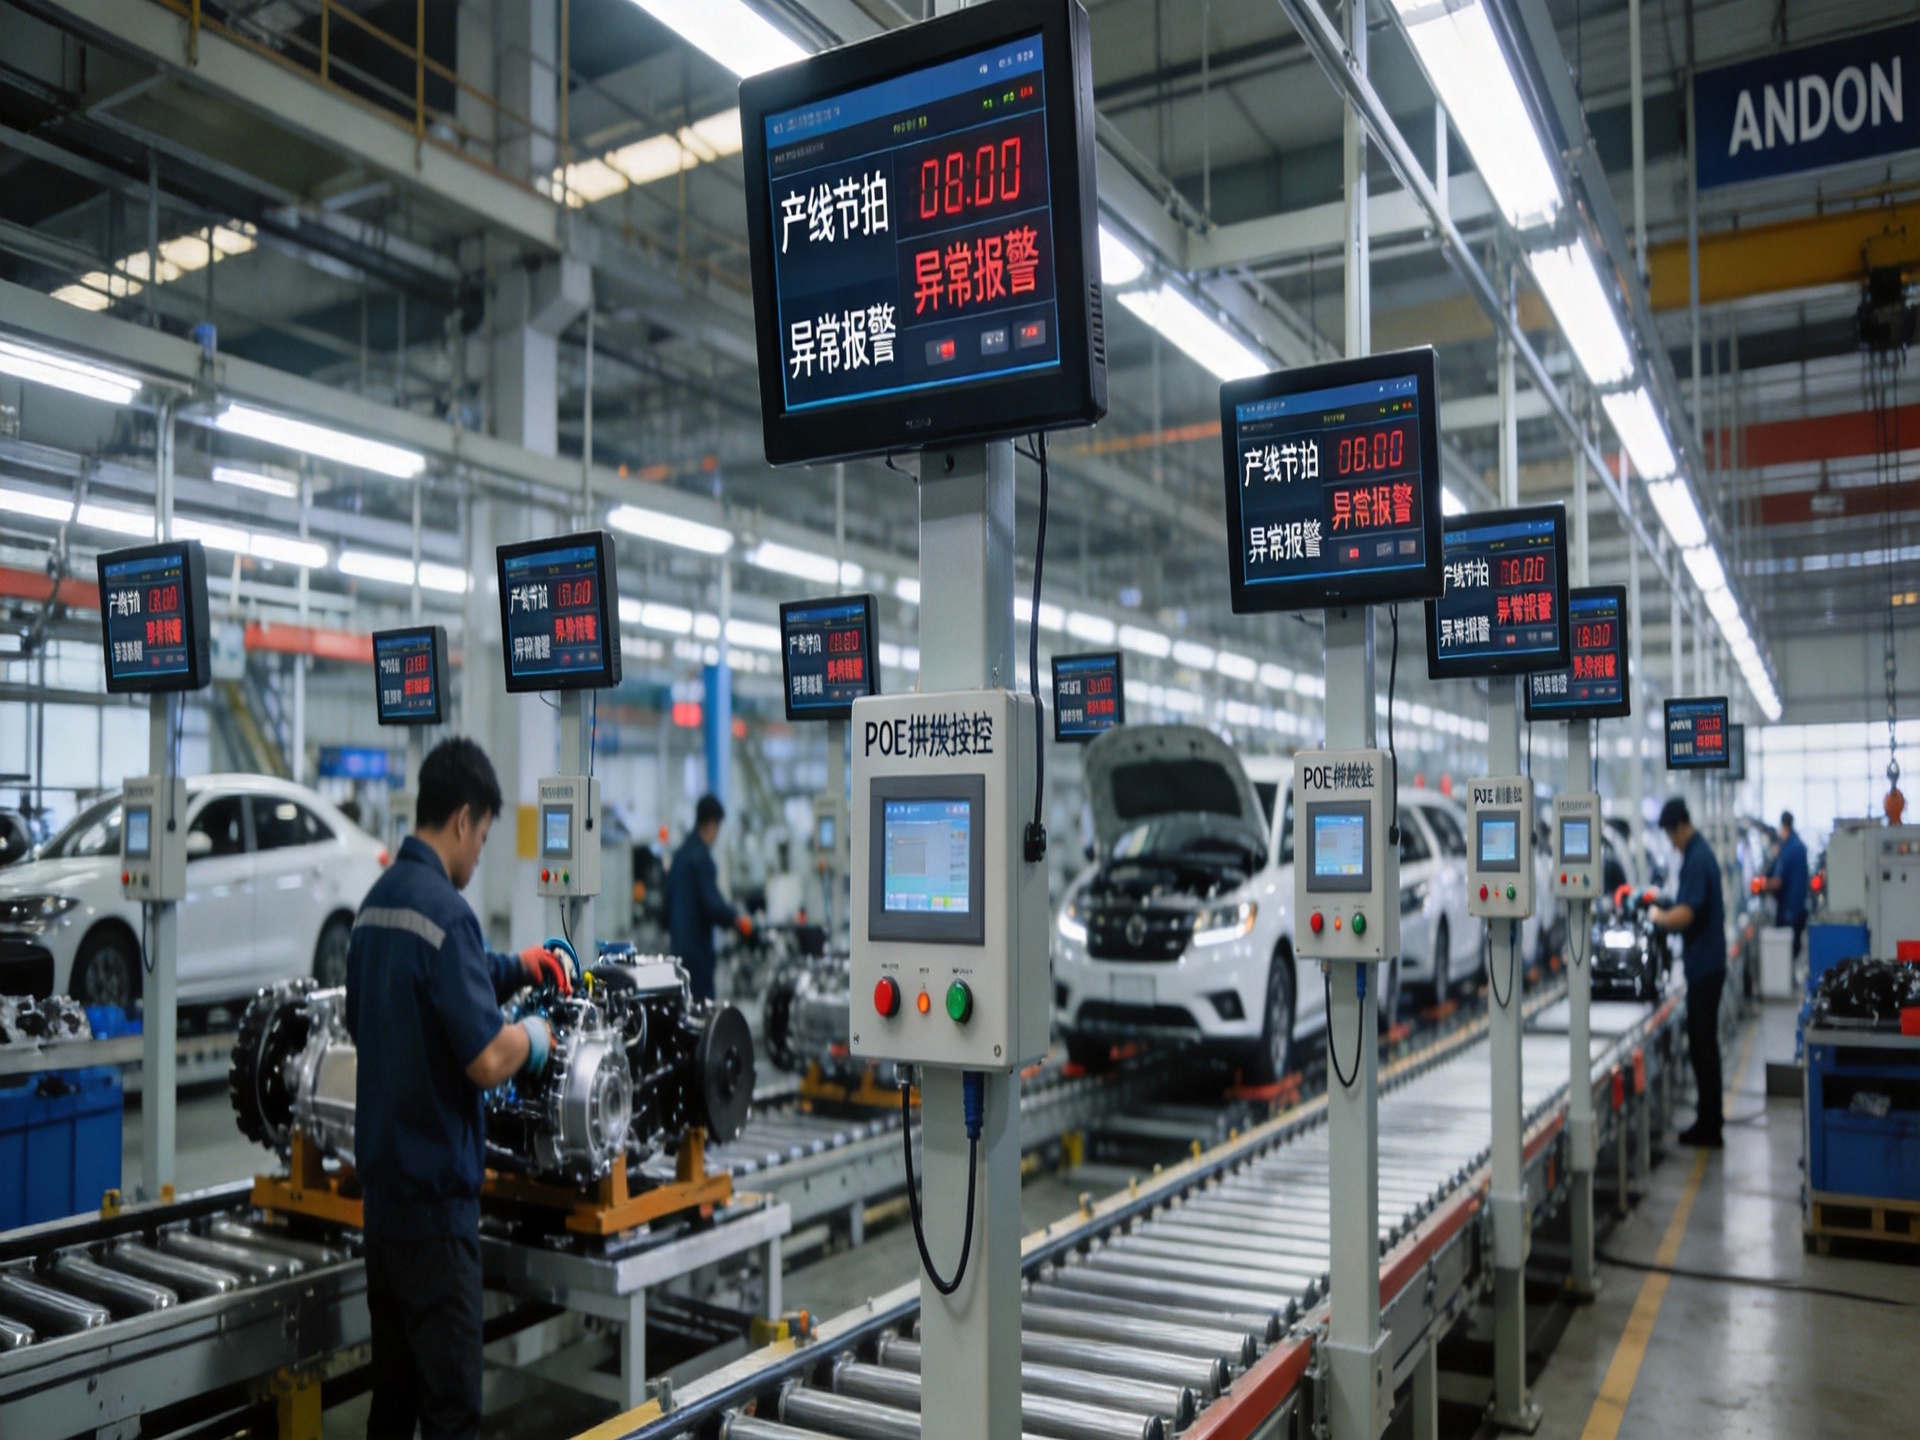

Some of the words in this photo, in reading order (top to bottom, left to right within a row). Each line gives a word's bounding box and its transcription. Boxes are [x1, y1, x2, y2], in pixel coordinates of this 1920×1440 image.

[1728, 55, 1904, 157] ANDON
[781, 170, 889, 254] 产线节拍
[920, 136, 1021, 219] 08:00
[914, 225, 1039, 315] 异常报警
[789, 302, 897, 379] 异常报警
[1244, 438, 1319, 487] 产线节拍
[1338, 429, 1404, 475] 08:00
[1248, 518, 1323, 564] 异常报警
[1332, 482, 1414, 531] 异常报警
